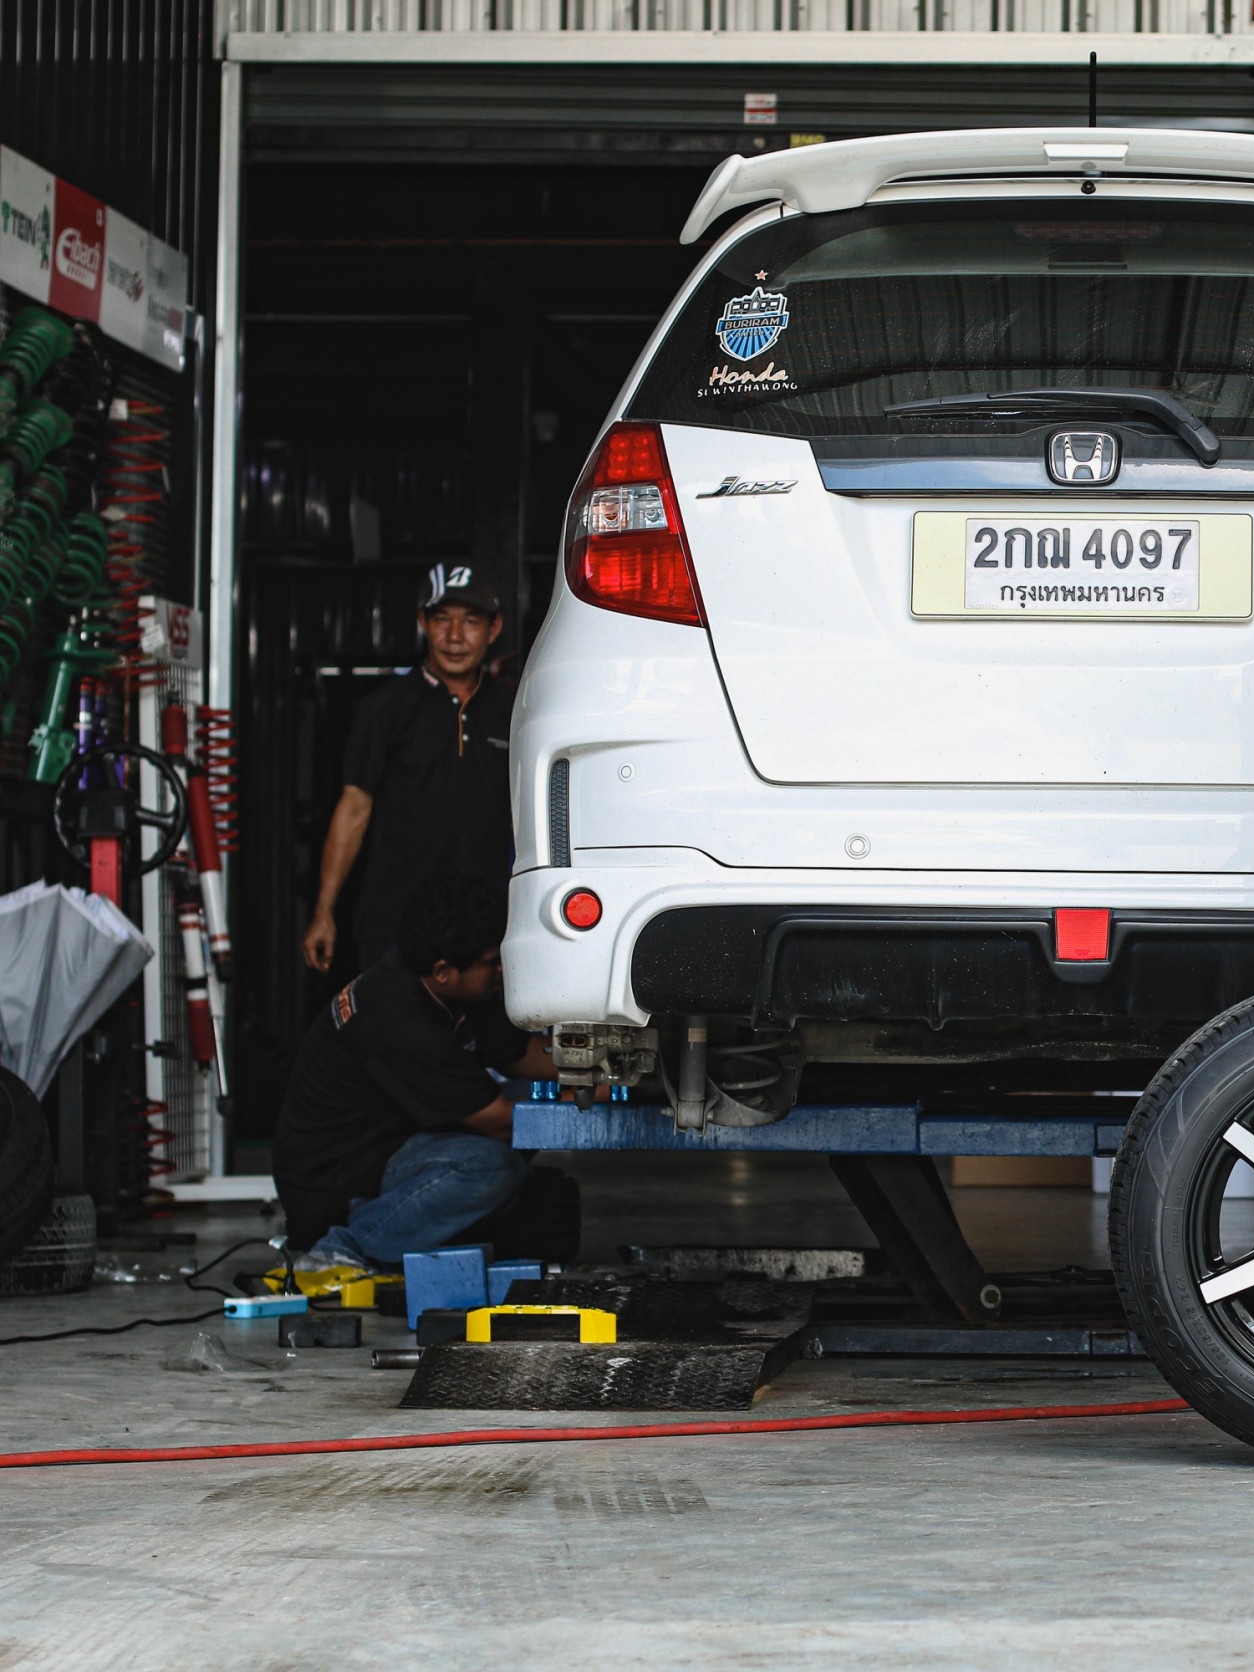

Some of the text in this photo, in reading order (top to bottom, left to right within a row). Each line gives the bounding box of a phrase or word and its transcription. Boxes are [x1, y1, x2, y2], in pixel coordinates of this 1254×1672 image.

[11, 207, 37, 246] TEIN
[56, 227, 100, 291] Eibach
[725, 317, 780, 330] BURIRAM
[708, 362, 789, 386] Honda
[696, 476, 799, 499] Jazz
[1082, 528, 1192, 570] 4097
[1000, 585, 1165, 608] กรุงเทพมหานคร
